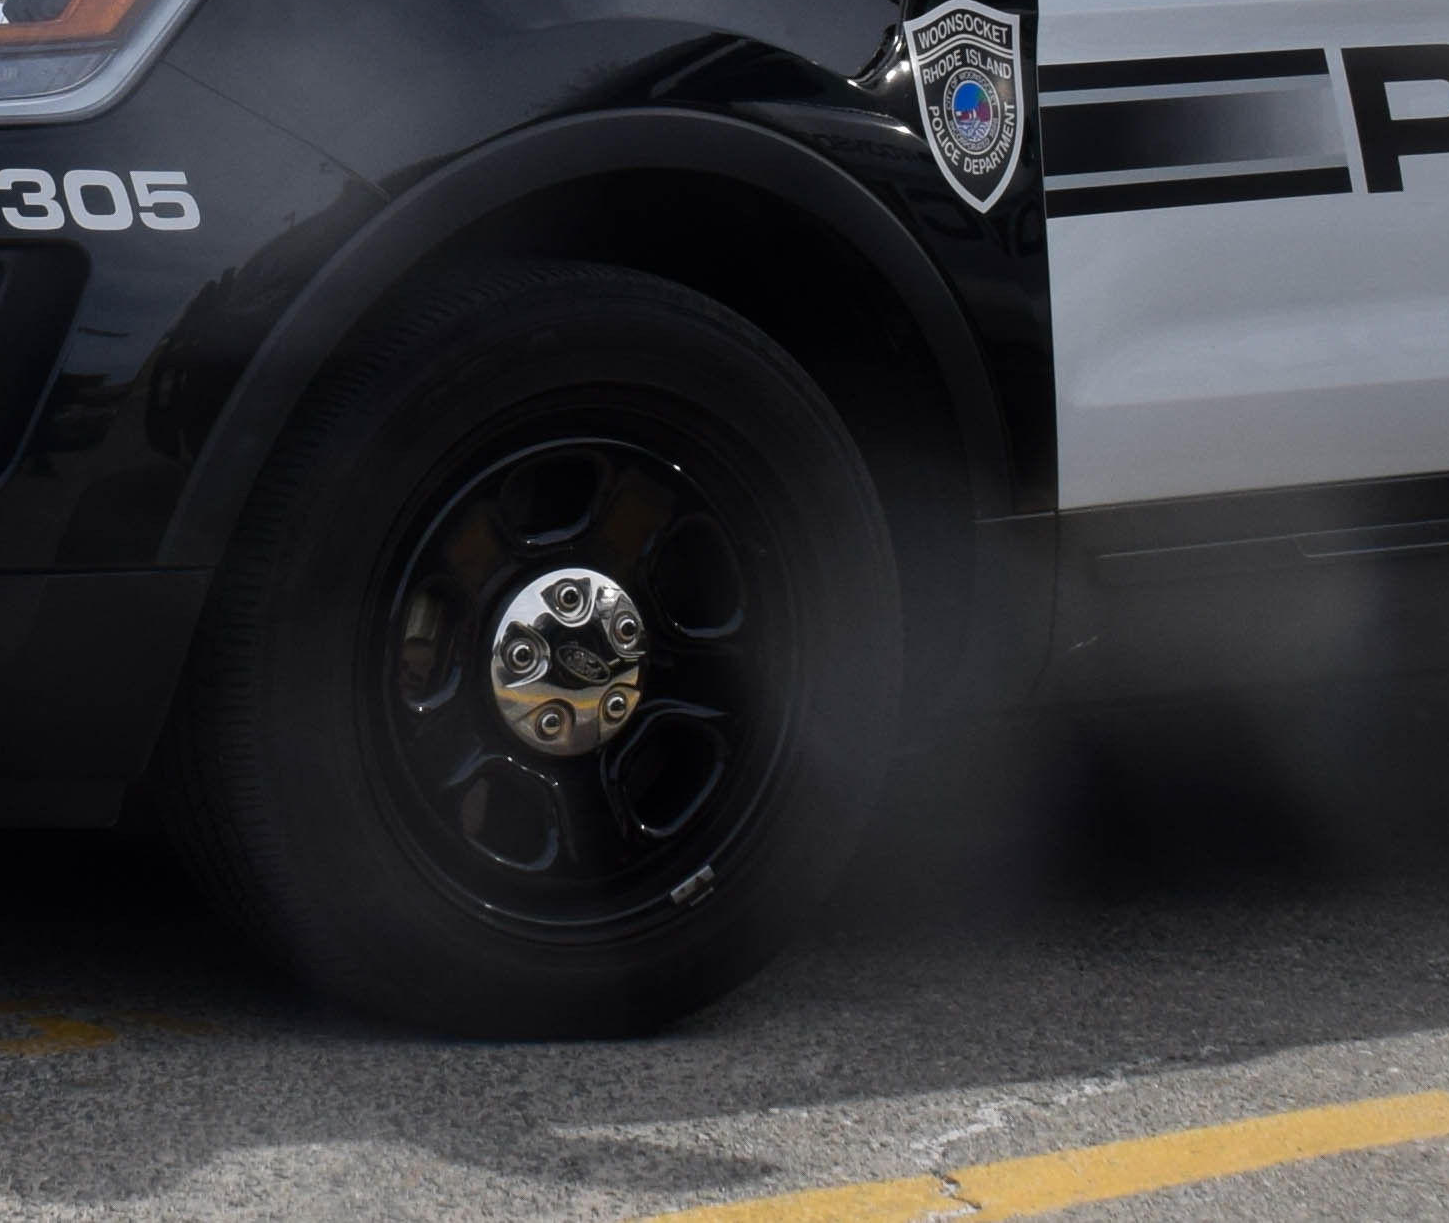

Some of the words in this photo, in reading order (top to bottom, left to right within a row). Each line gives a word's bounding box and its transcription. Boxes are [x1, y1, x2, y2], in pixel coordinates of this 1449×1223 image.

[917, 14, 1009, 50] WOONSOCKET
[922, 49, 962, 85] RHODE
[965, 48, 1012, 80] ISLAND
[929, 105, 962, 166] POLICE
[963, 101, 1016, 176] DEPARTMENT
